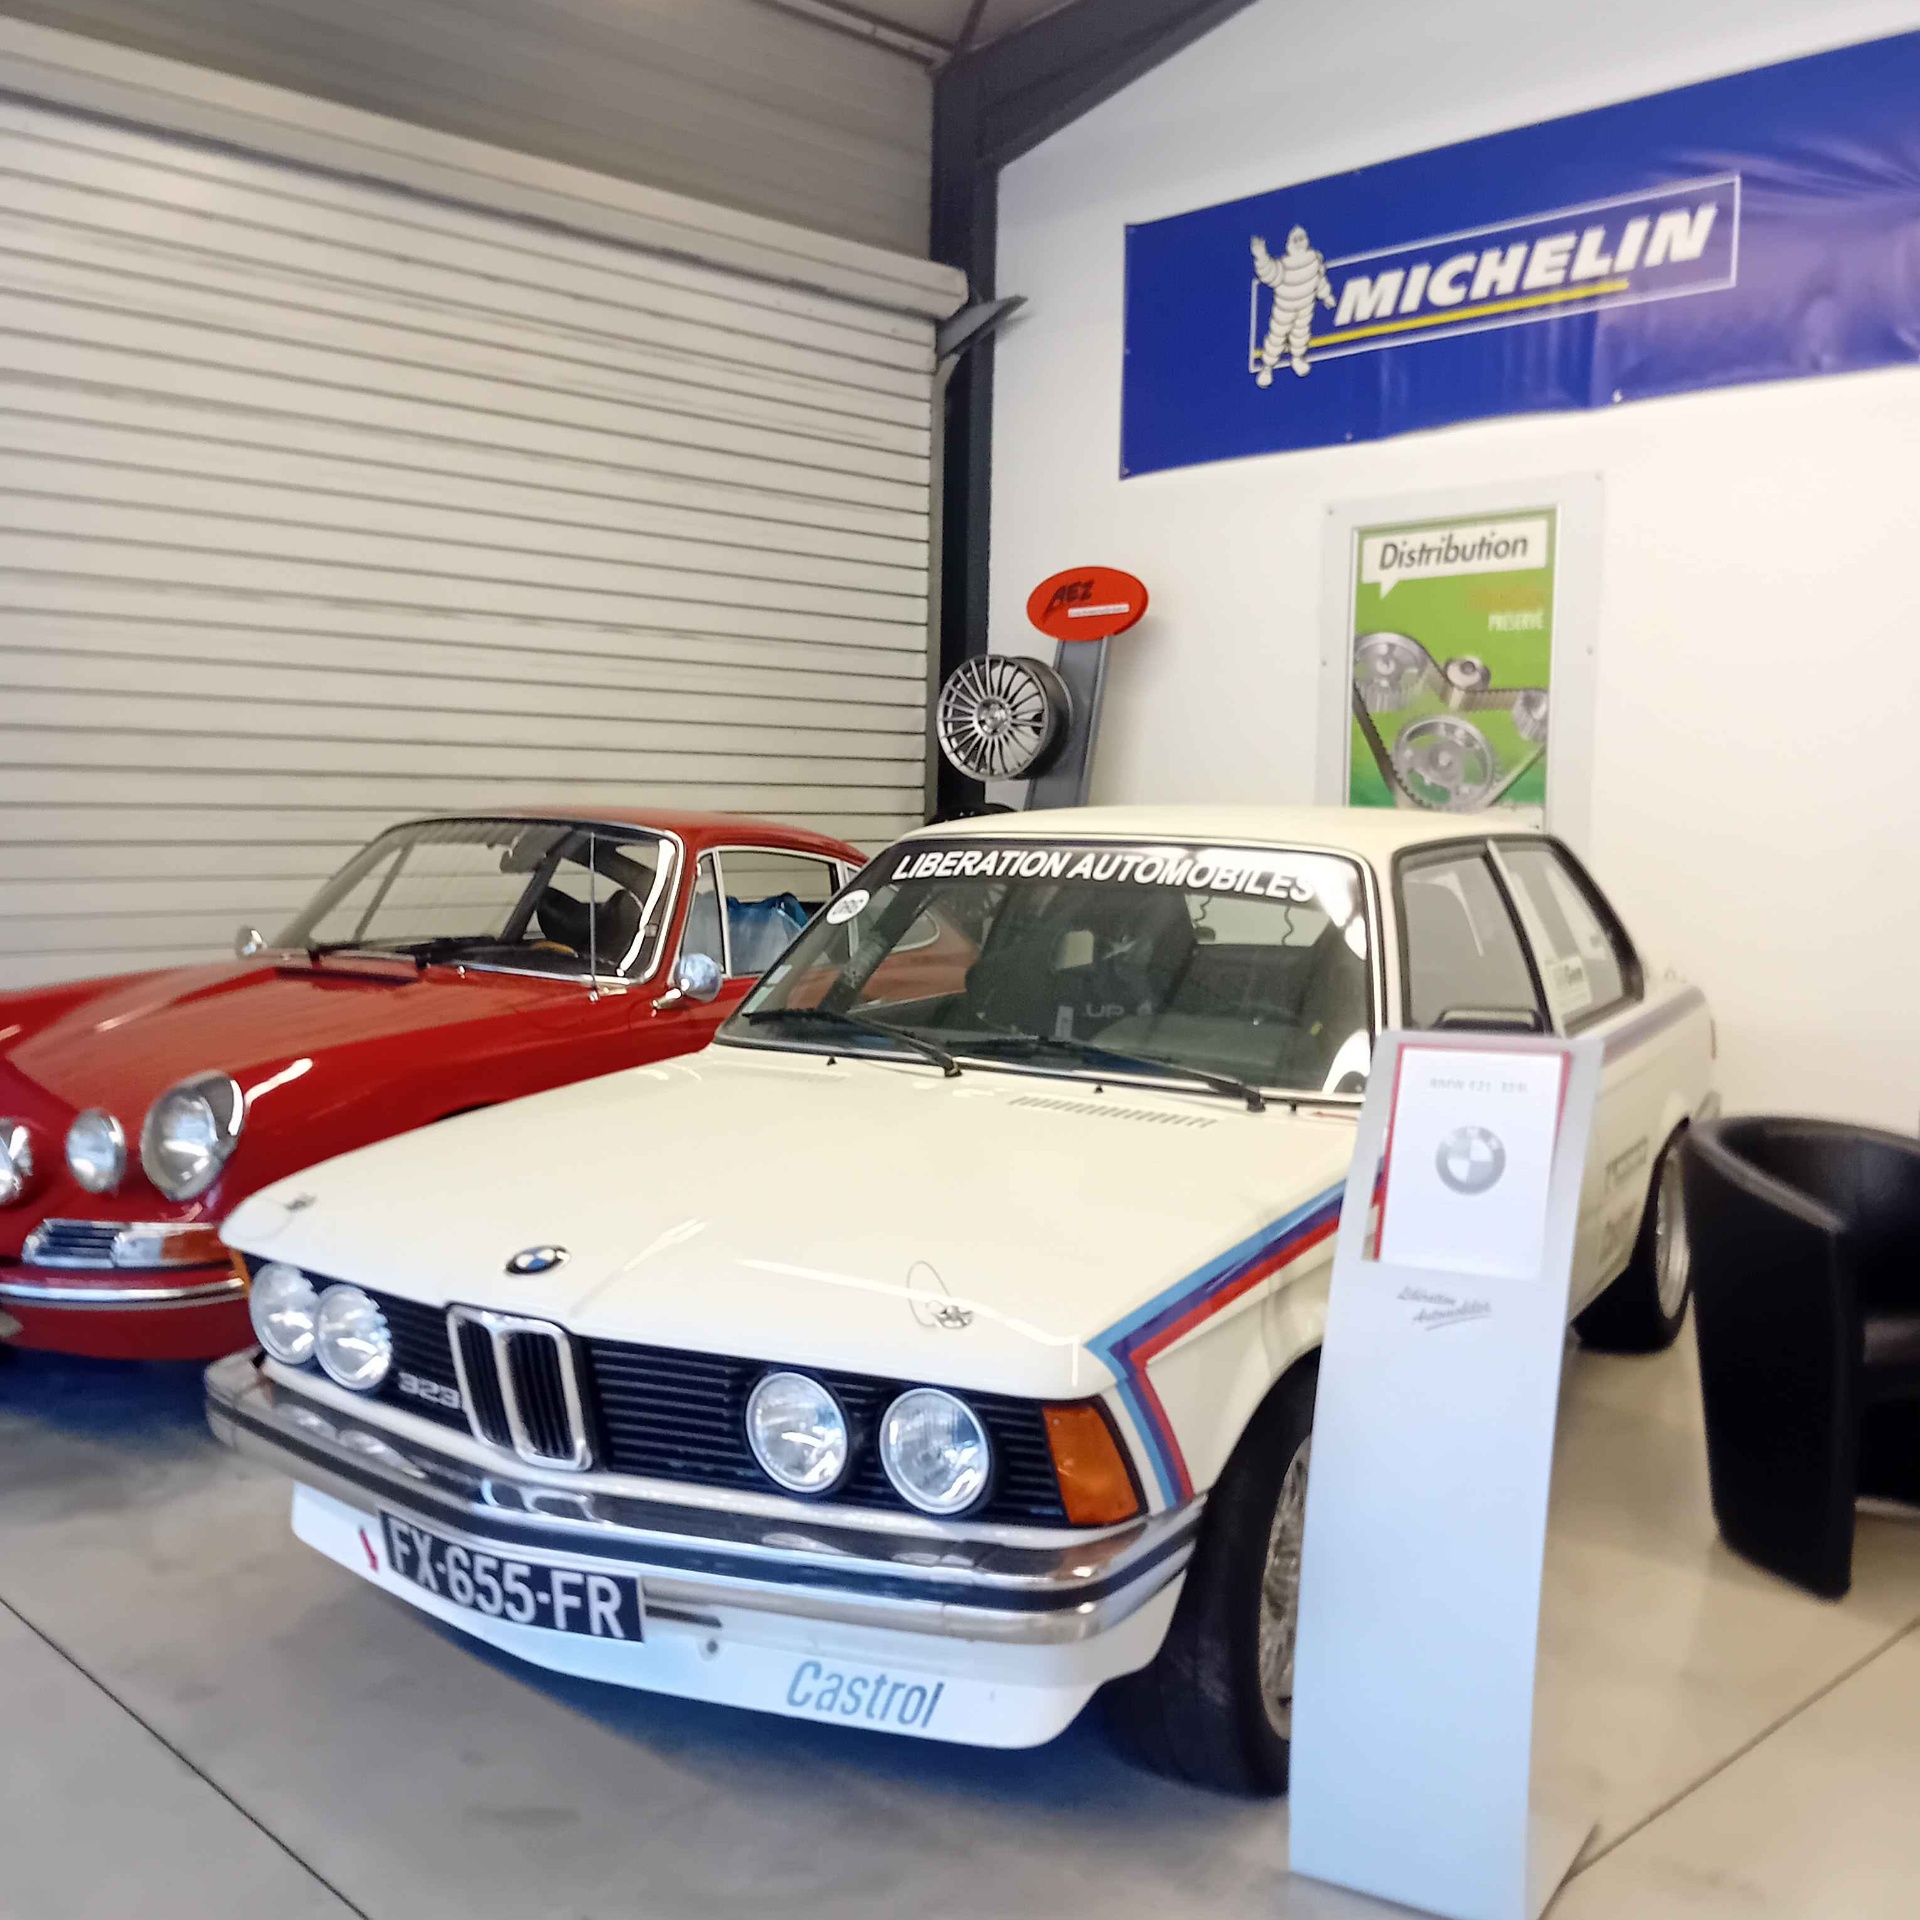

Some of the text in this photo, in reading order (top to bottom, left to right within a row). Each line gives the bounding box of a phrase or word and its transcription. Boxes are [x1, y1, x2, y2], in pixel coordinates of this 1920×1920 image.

[1334, 203, 1718, 326] MICHELIN
[1379, 532, 1528, 571] Distribution
[892, 850, 1314, 902] LIBERATION AUTOMOBILES
[388, 1518, 625, 1639] FX-655-FR
[786, 1660, 945, 1728] Castrol
